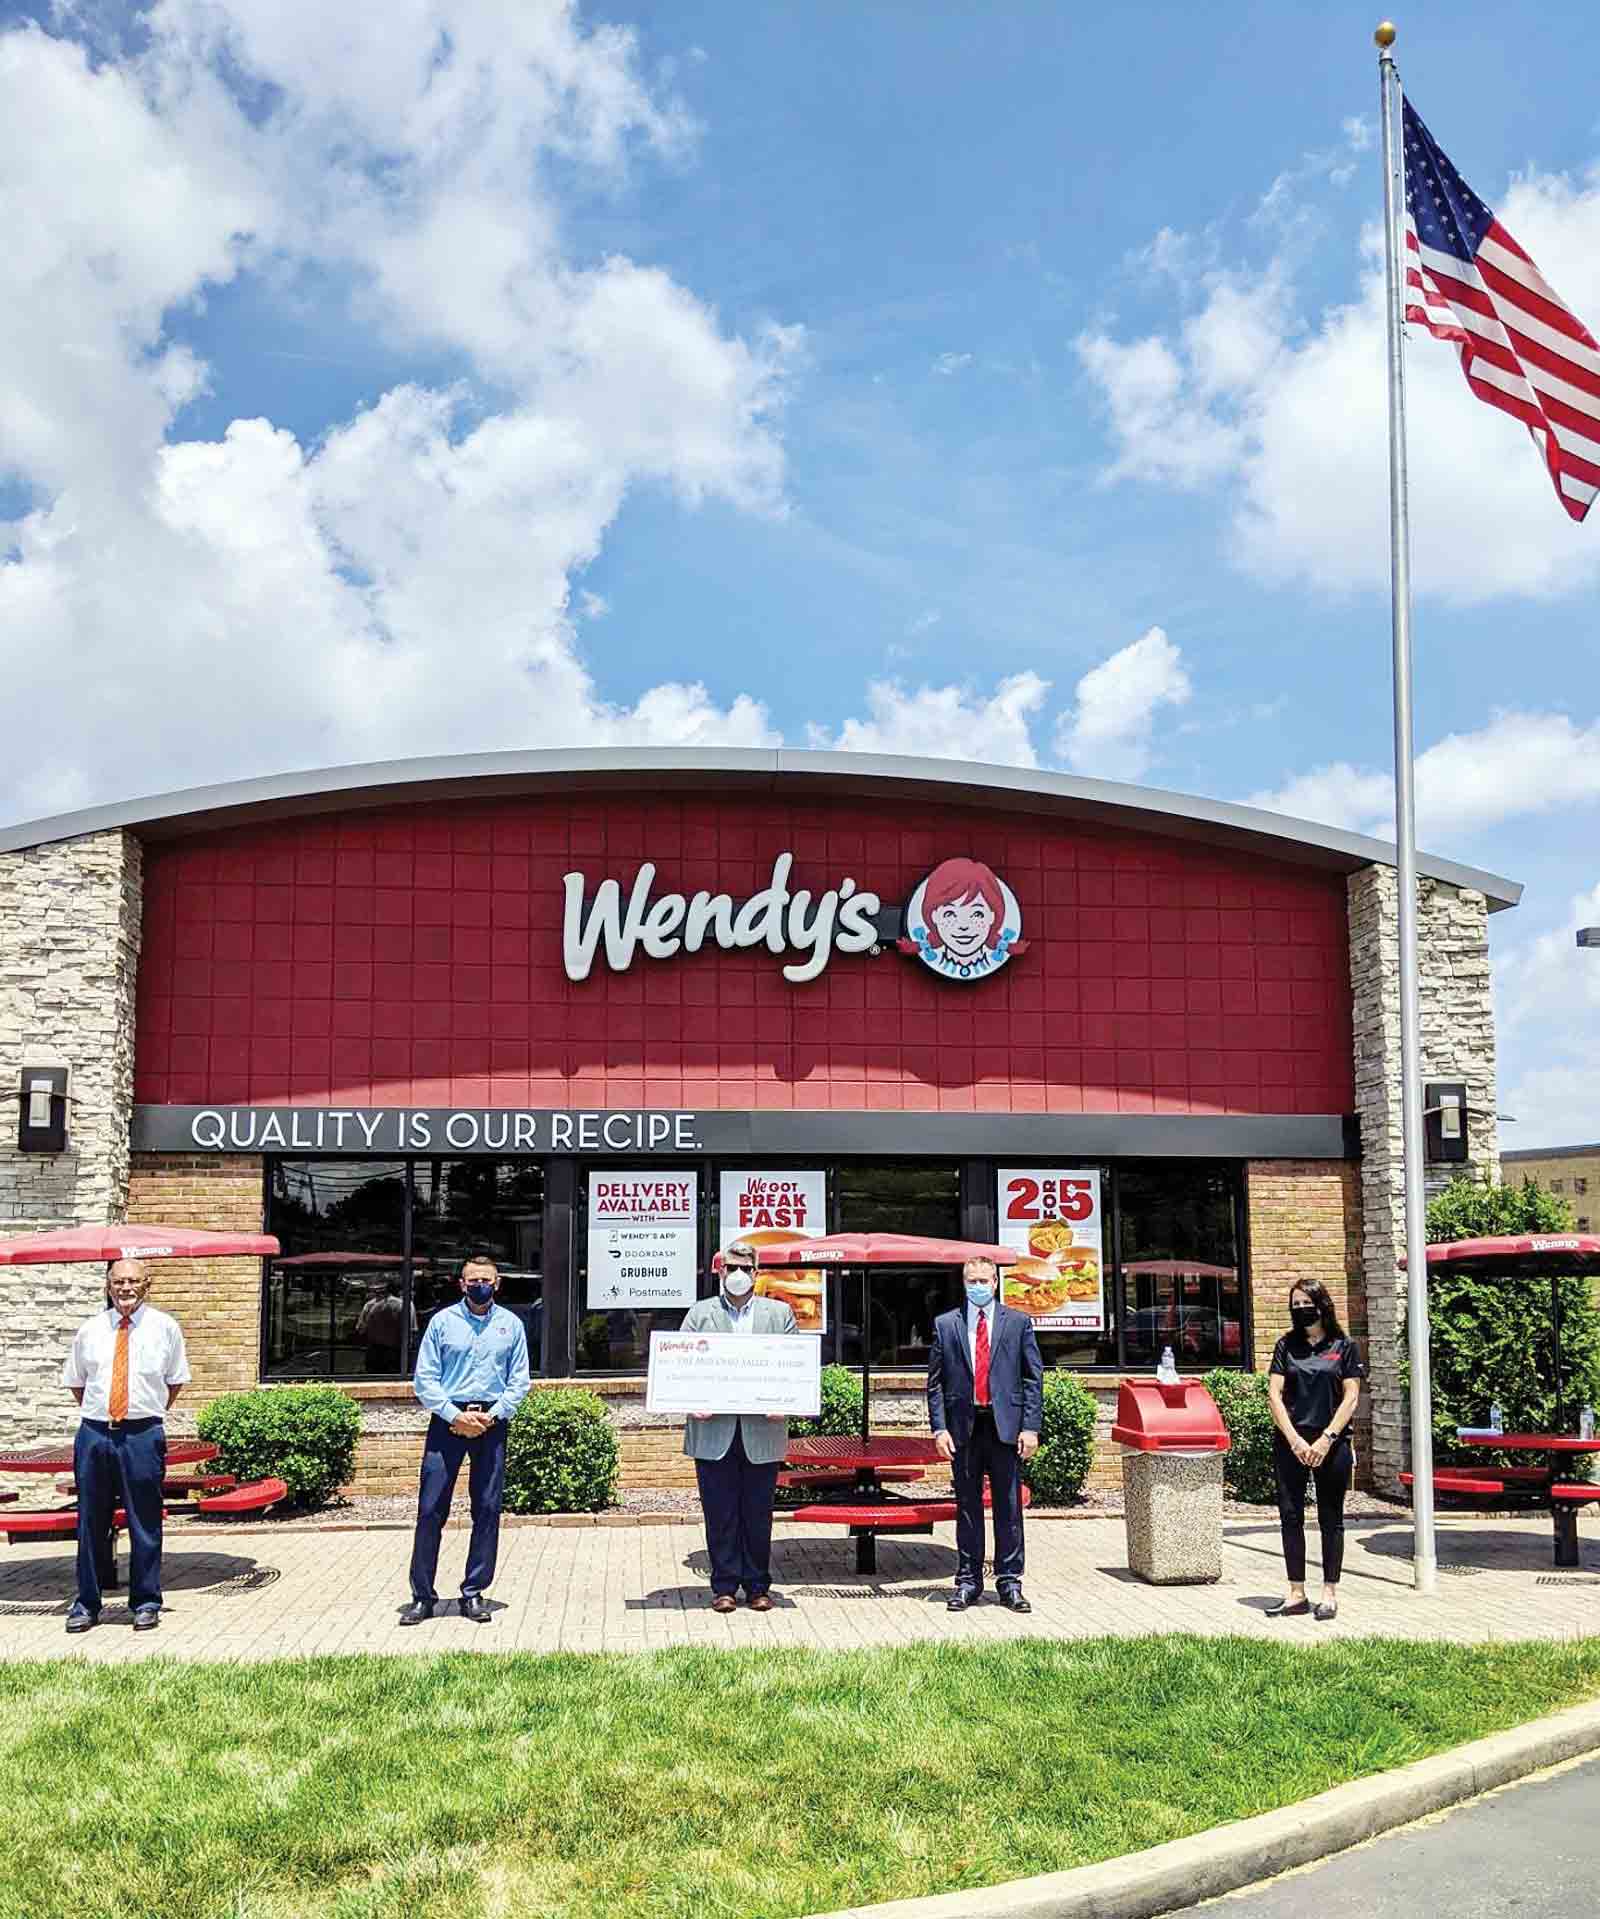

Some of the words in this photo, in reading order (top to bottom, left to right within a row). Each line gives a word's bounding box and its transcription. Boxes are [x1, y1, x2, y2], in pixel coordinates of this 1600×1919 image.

[563, 852, 881, 982] Wendy's
[191, 1111, 385, 1149] QUALITY
[398, 1112, 432, 1148] IS
[446, 1112, 536, 1148] OUR
[551, 1113, 703, 1149] RECIPE.
[597, 1183, 689, 1197] DELIVERY
[747, 1177, 767, 1195] We
[769, 1182, 798, 1193] GOT
[597, 1199, 690, 1212] AVAILABLE
[739, 1194, 806, 1207] BREAK
[1007, 1178, 1040, 1219] 2
[1042, 1180, 1056, 1219] FOR
[739, 1209, 807, 1228] FAST
[620, 1232, 658, 1240] WENDY'S
[659, 1232, 676, 1240] APP
[620, 1267, 668, 1278] GRUBHUB
[629, 1287, 683, 1297] Postmates
